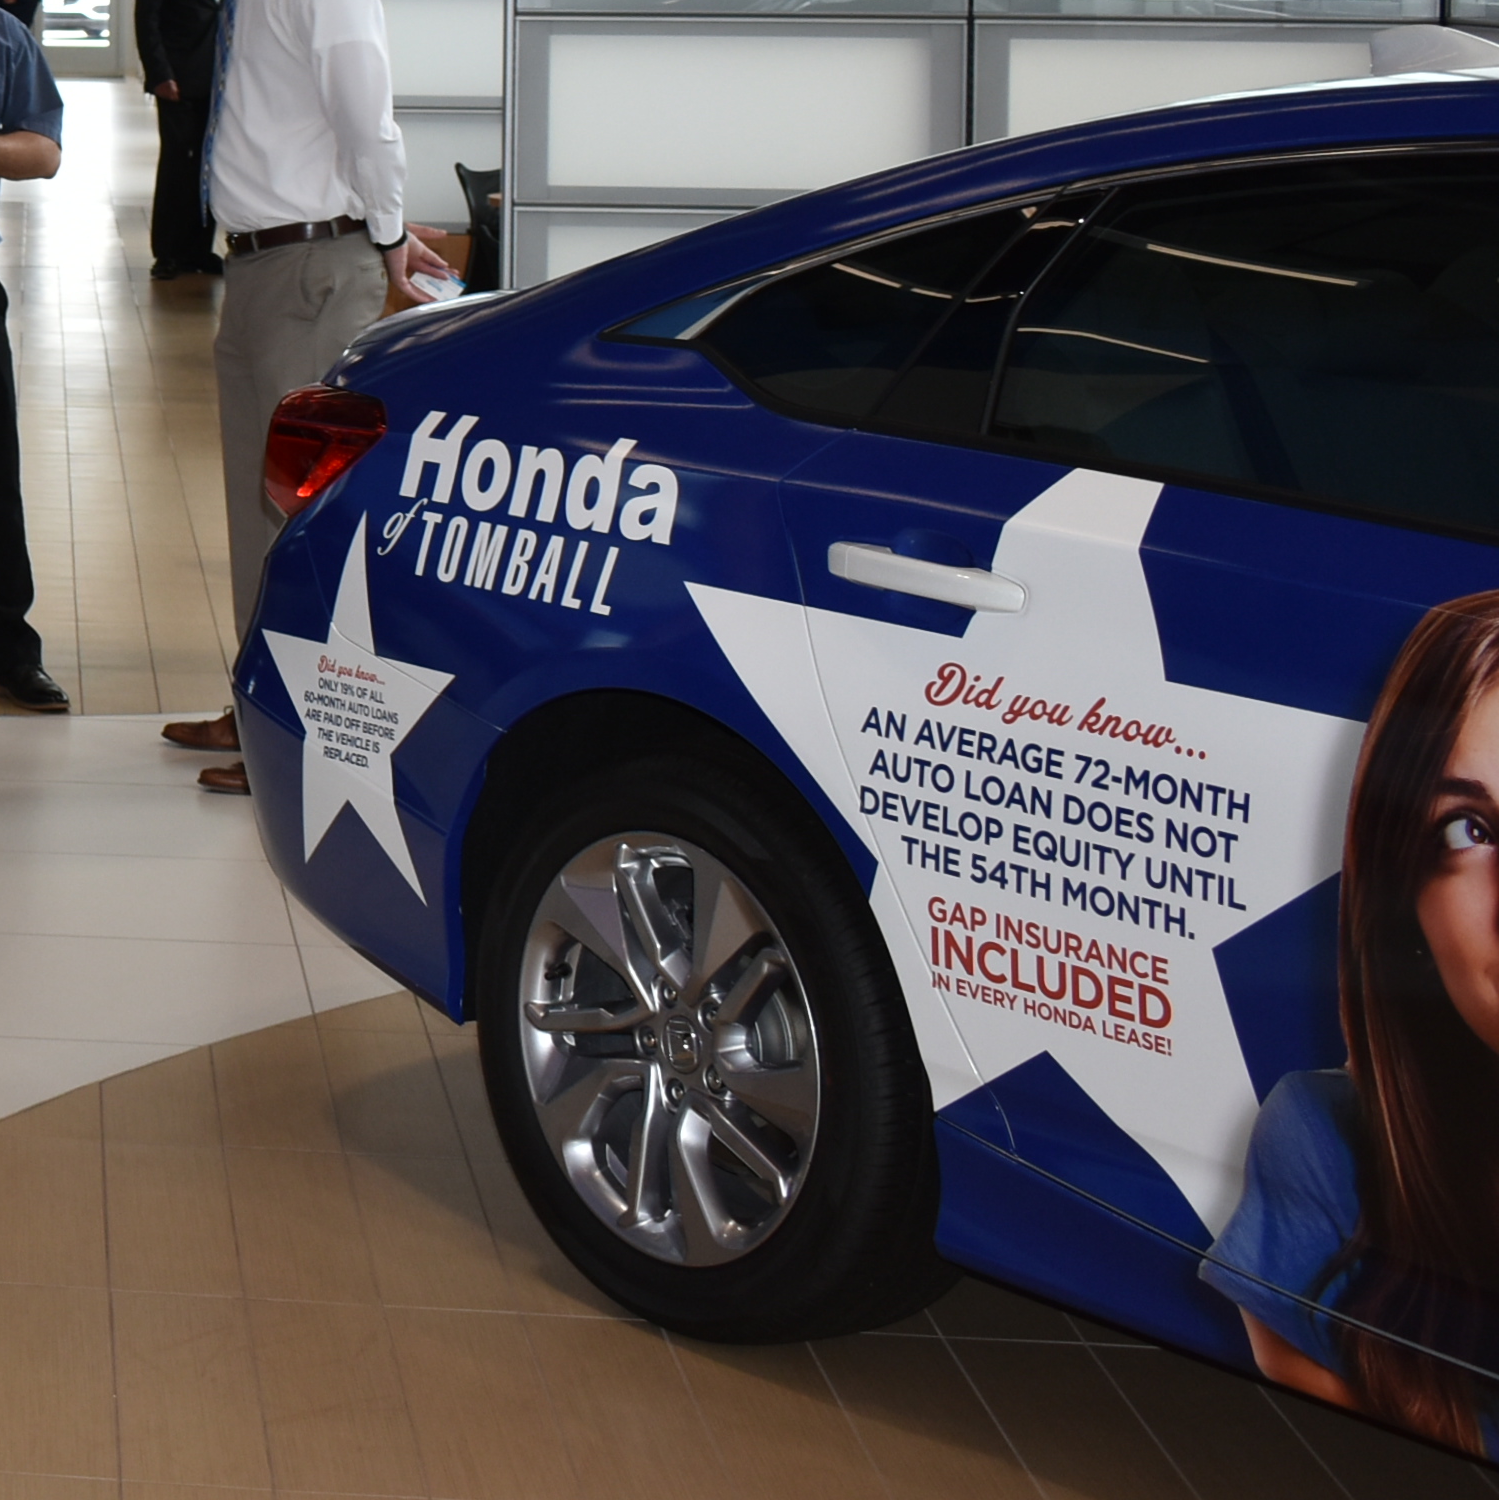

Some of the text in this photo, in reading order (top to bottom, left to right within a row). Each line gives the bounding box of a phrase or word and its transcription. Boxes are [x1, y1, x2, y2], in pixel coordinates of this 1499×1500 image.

[399, 410, 679, 546] Honda
[377, 498, 620, 616] of TOMBALL
[304, 690, 399, 725] 60-MONTH AUTO LOANS
[318, 655, 337, 673] Did
[337, 666, 353, 678] you
[318, 677, 385, 704] ONLY 19% OF ALL
[925, 662, 1207, 760] Did you know...
[304, 708, 395, 741] ARE PAID OFF BEFORE
[317, 727, 380, 754] THE VEHICLE IS
[323, 745, 369, 768] REPLACED.
[860, 706, 1252, 824] AN AVERAGE 72-MONTH
[859, 784, 1247, 912] DEVELOP EQUITY UNTIL
[868, 748, 1239, 864] AUTO LOAN DOES NOT
[900, 834, 1196, 940] THE 54TH MONTH.
[927, 896, 1170, 985] GAP INSURANCE
[930, 926, 1173, 1029] INCLUDED
[931, 971, 1173, 1057] IN EVERY HONDA LEASE!
